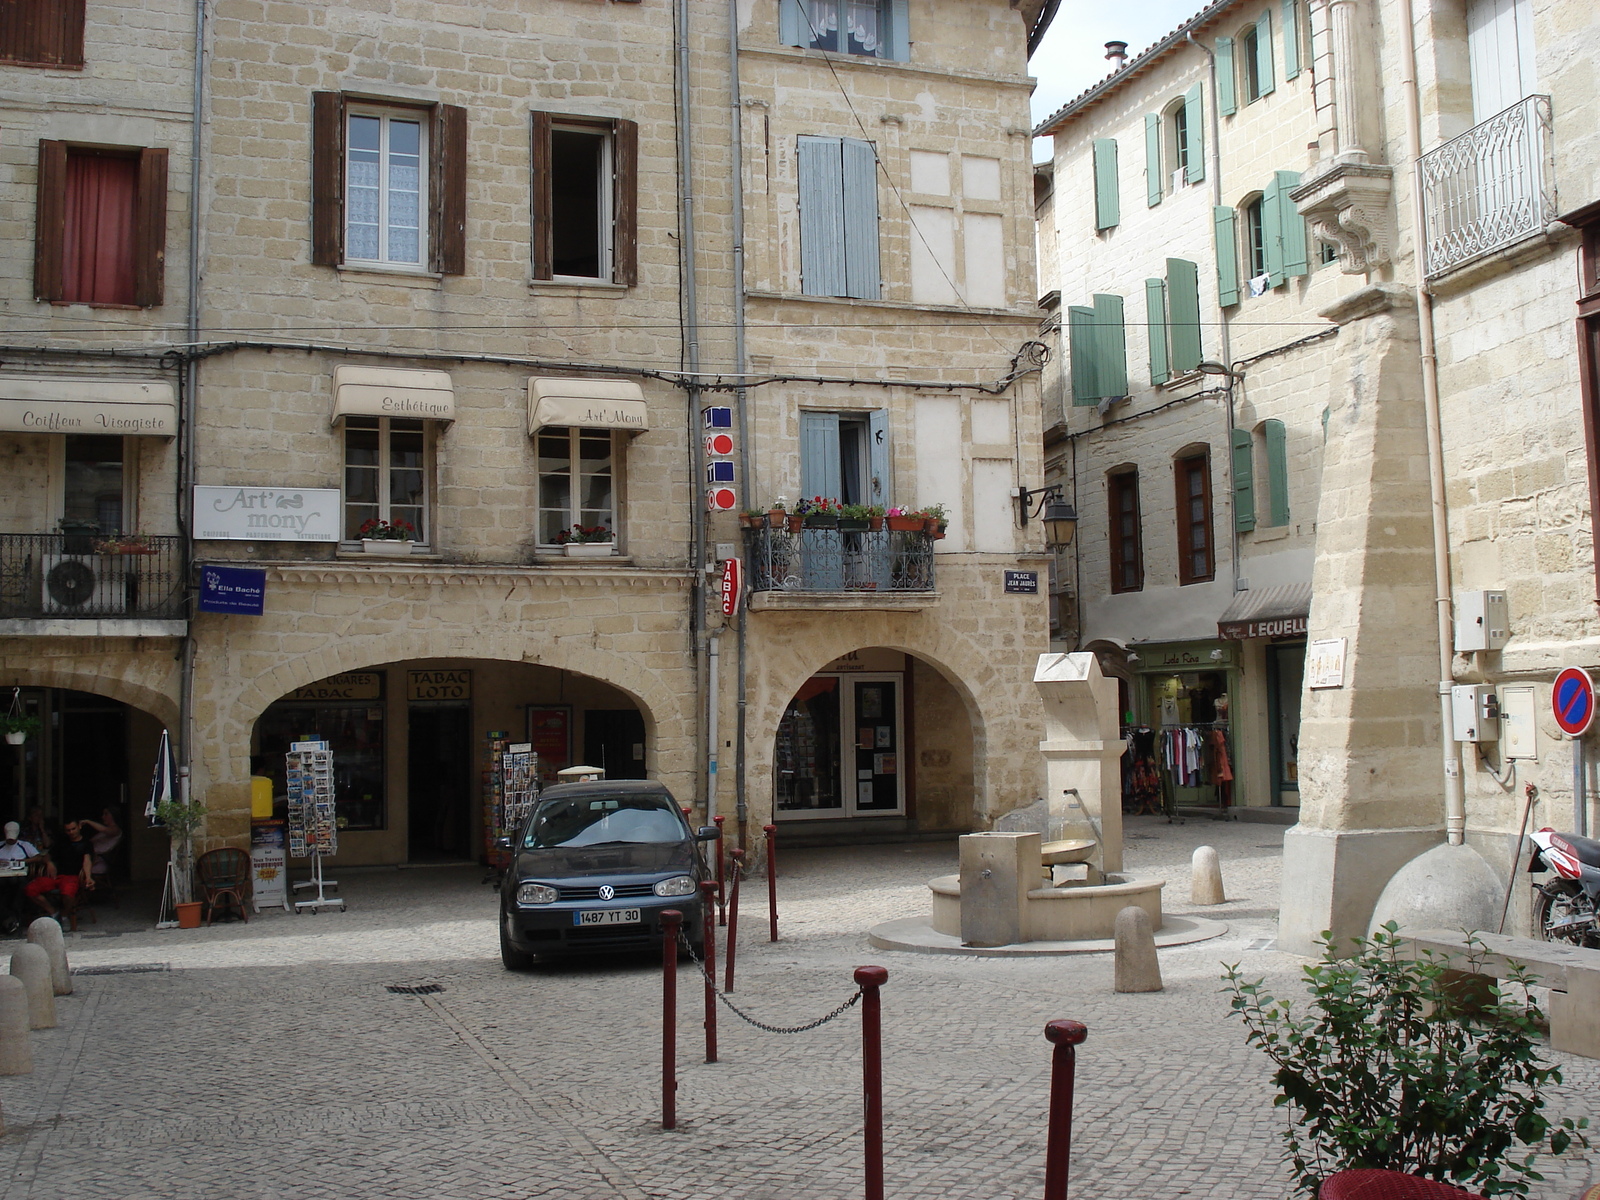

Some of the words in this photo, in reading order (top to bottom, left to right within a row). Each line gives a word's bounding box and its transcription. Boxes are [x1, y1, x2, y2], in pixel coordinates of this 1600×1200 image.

[381, 396, 449, 416] Esthétique
[22, 411, 82, 430] Coiffeur
[93, 413, 165, 432] Visagiste
[247, 511, 321, 534] mony
[235, 586, 261, 594] Baché
[722, 560, 733, 613] TABAC
[326, 675, 371, 685] CIGARES
[411, 672, 469, 684] TABAC
[294, 688, 353, 698] TABAC
[416, 685, 464, 698] LOTO
[580, 912, 605, 923] 1487
[608, 911, 621, 922] YT
[625, 910, 639, 921] 30
